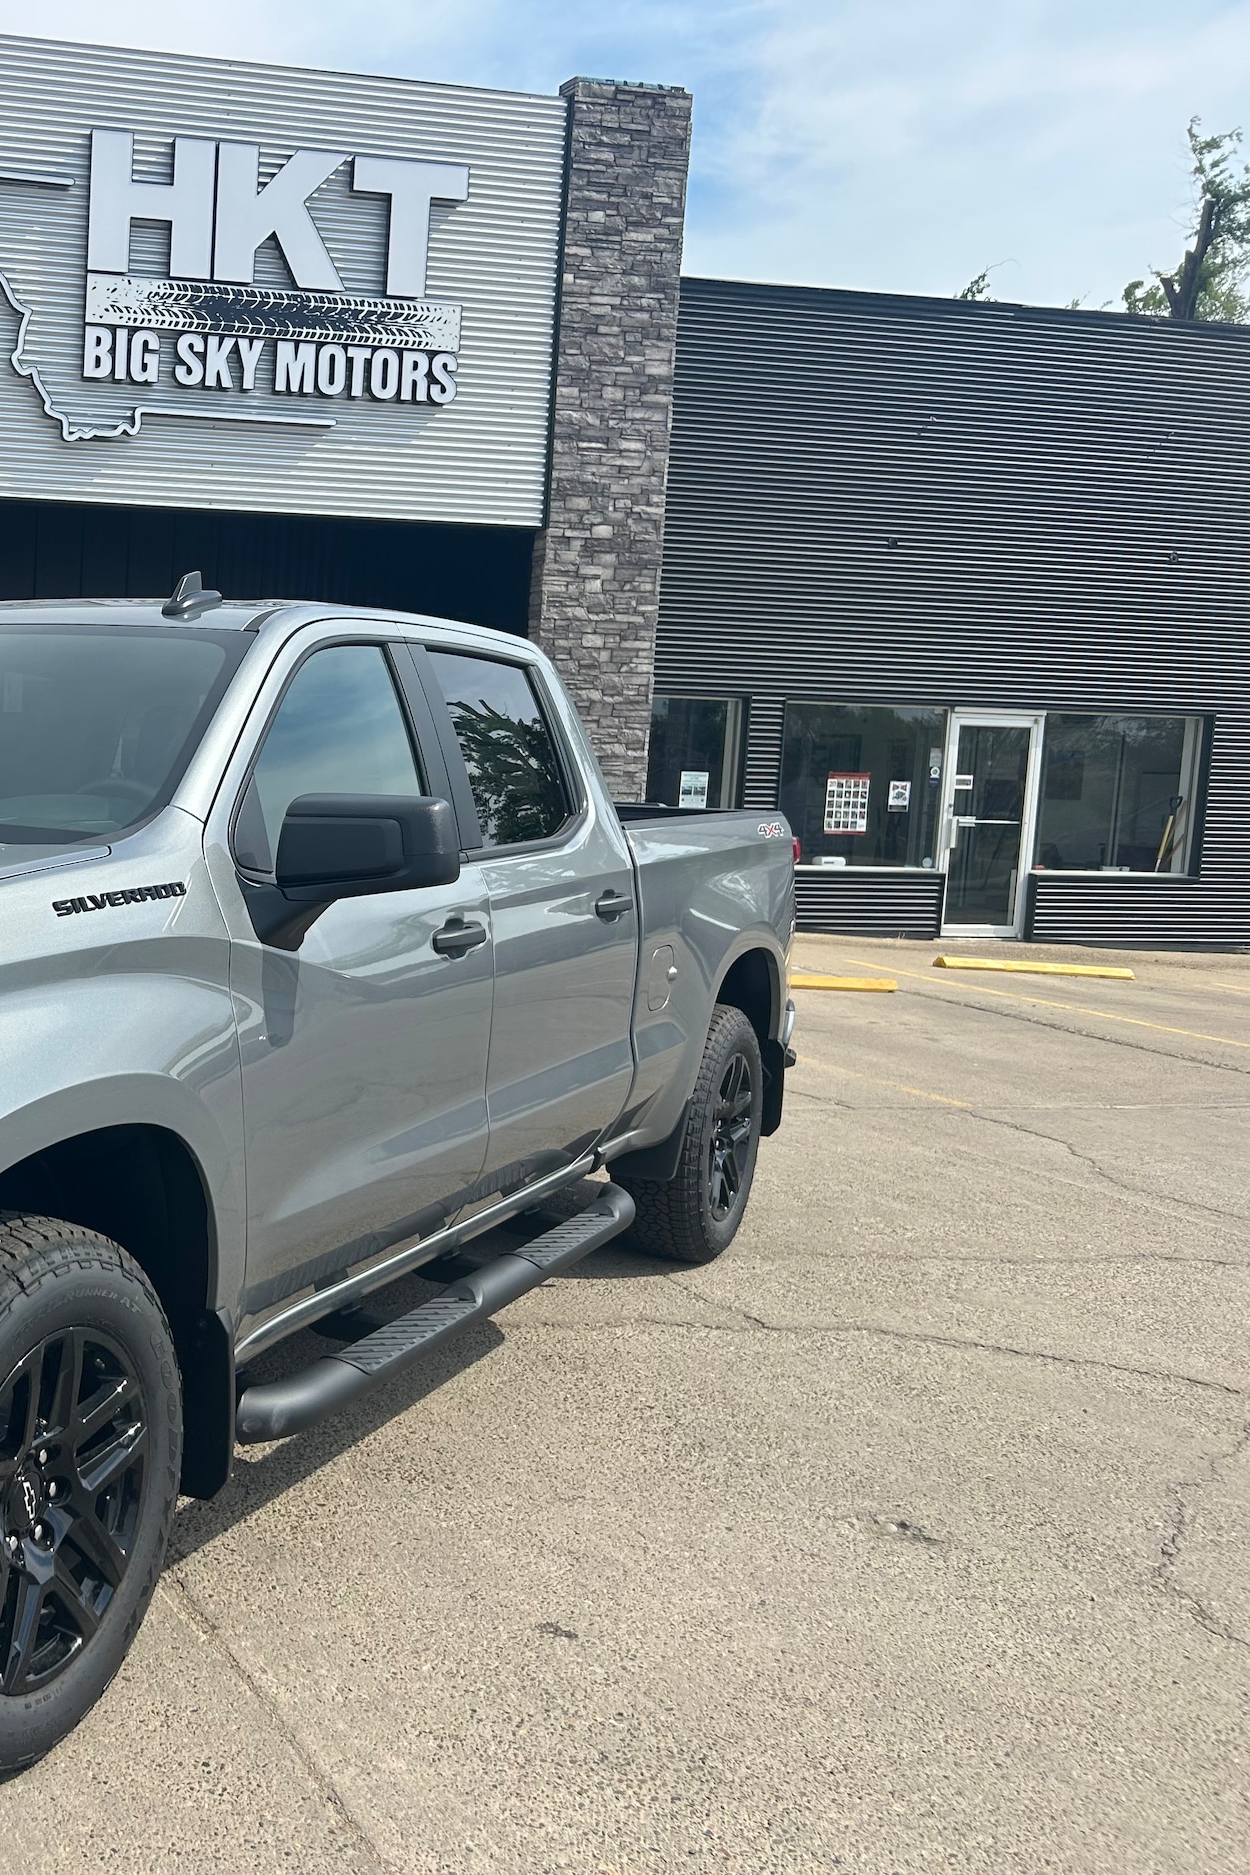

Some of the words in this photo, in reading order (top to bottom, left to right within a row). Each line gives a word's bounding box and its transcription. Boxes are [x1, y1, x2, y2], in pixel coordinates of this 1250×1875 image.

[86, 128, 470, 299] HKT
[83, 324, 161, 384] BIG
[173, 334, 266, 390] SKY
[274, 340, 459, 404] MOTORS
[52, 881, 187, 917] SILVERADO
